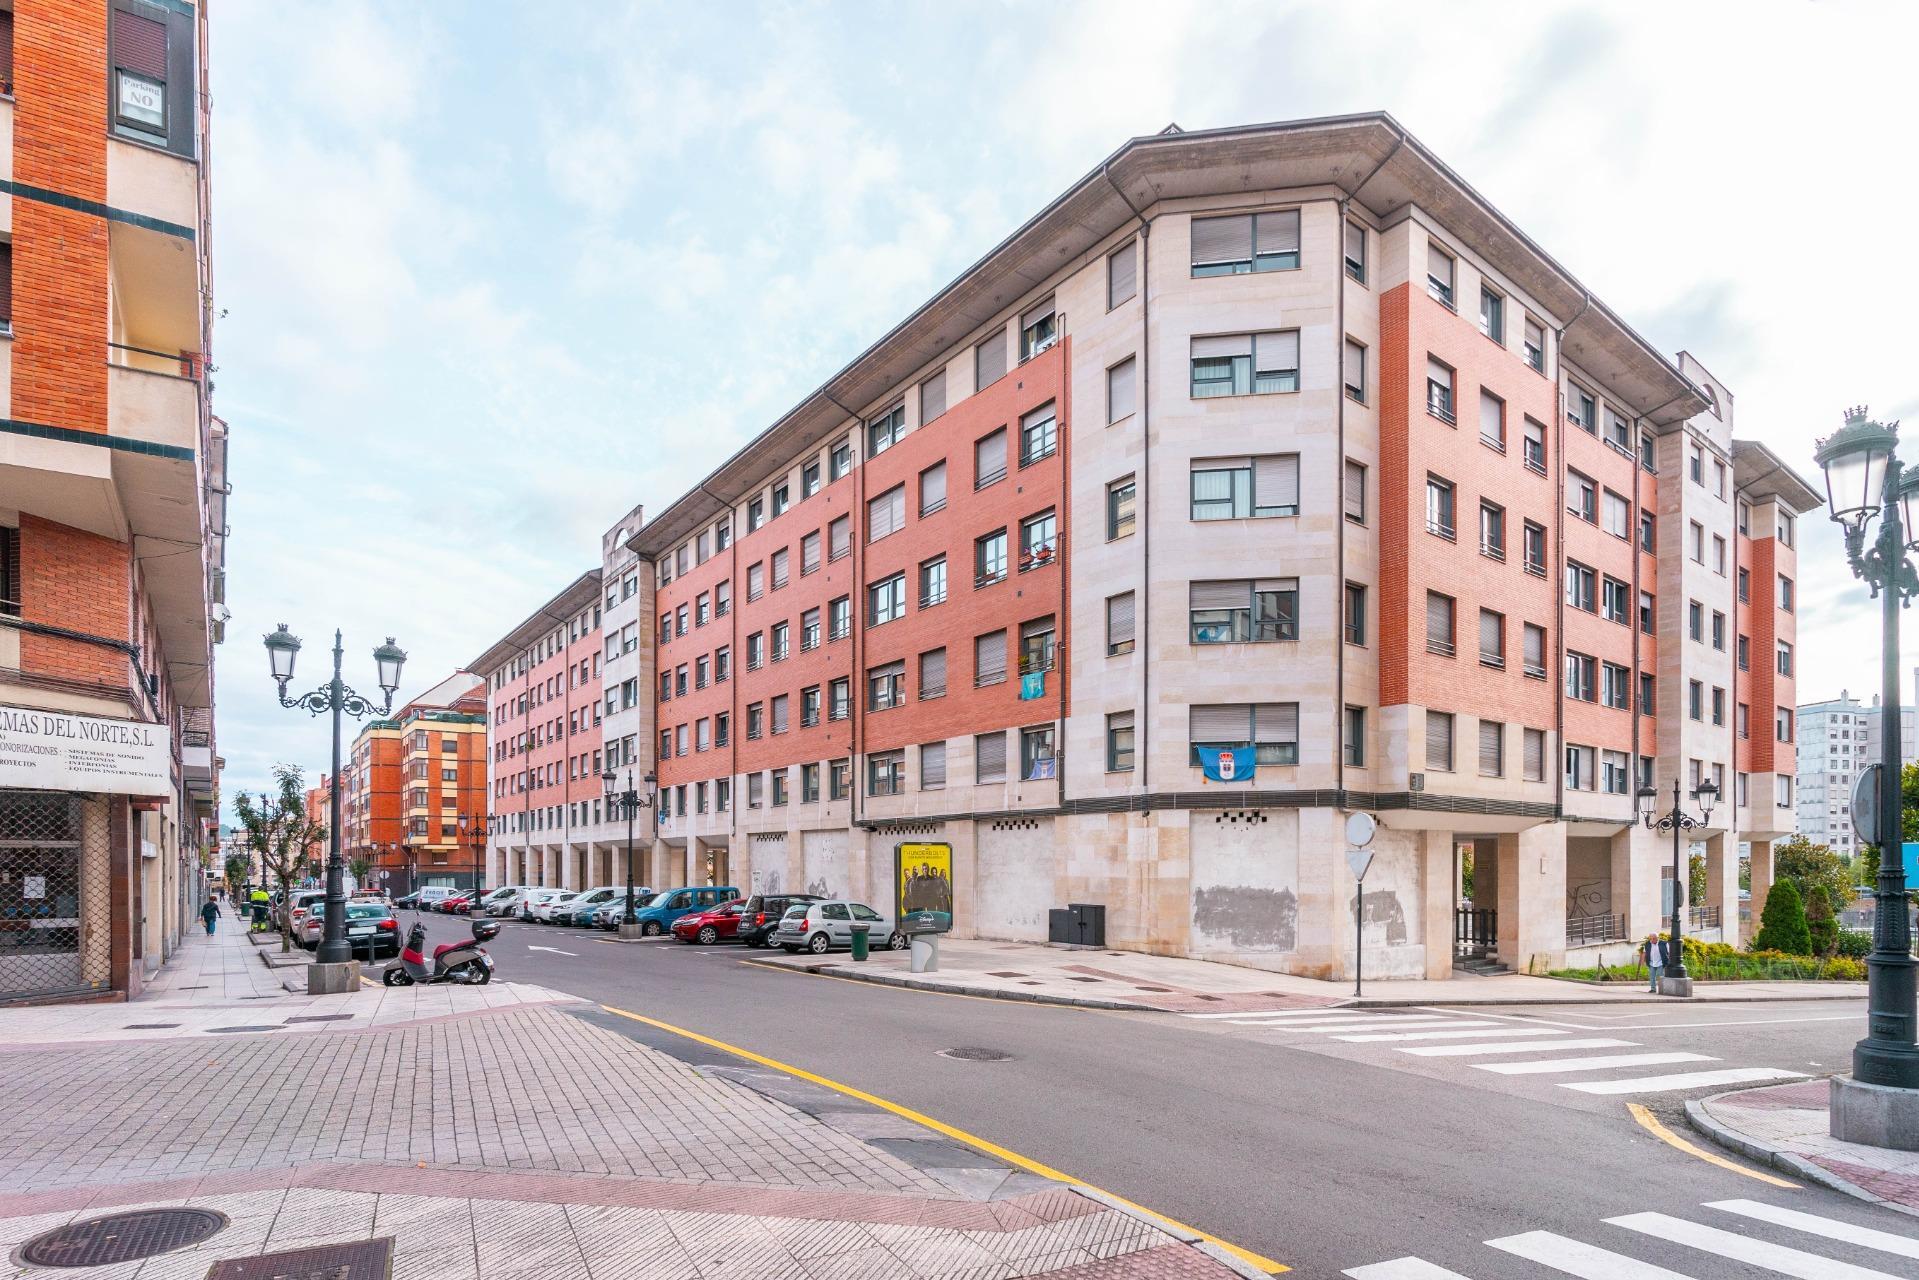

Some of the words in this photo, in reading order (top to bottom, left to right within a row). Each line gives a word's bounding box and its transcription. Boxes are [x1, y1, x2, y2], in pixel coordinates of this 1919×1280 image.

[124, 78, 161, 96] Parking
[130, 91, 153, 107] NO
[0, 711, 39, 734] MAS
[43, 716, 76, 739] DEL
[68, 749, 104, 757] SISTEMAS
